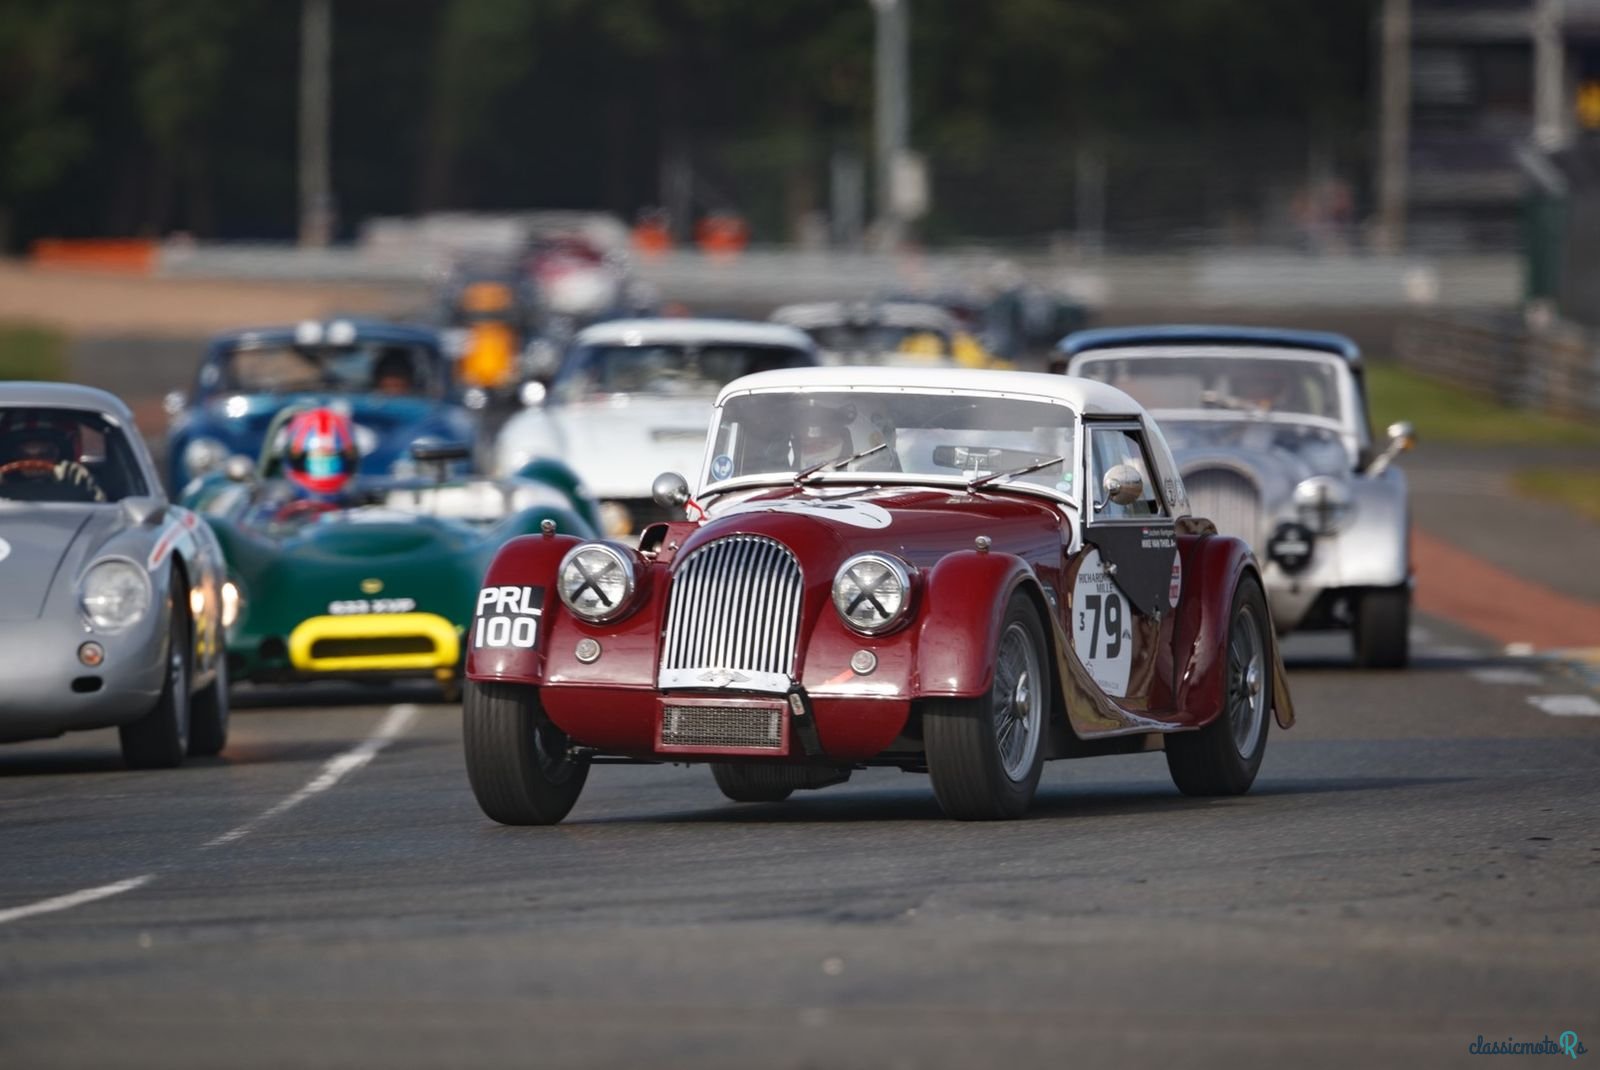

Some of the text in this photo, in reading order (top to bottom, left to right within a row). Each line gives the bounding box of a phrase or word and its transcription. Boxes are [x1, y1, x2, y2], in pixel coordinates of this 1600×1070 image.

[476, 586, 543, 616] PRL
[1096, 583, 1113, 593] MILLE
[475, 616, 537, 648] 100
[1079, 593, 1122, 659] 3 79
